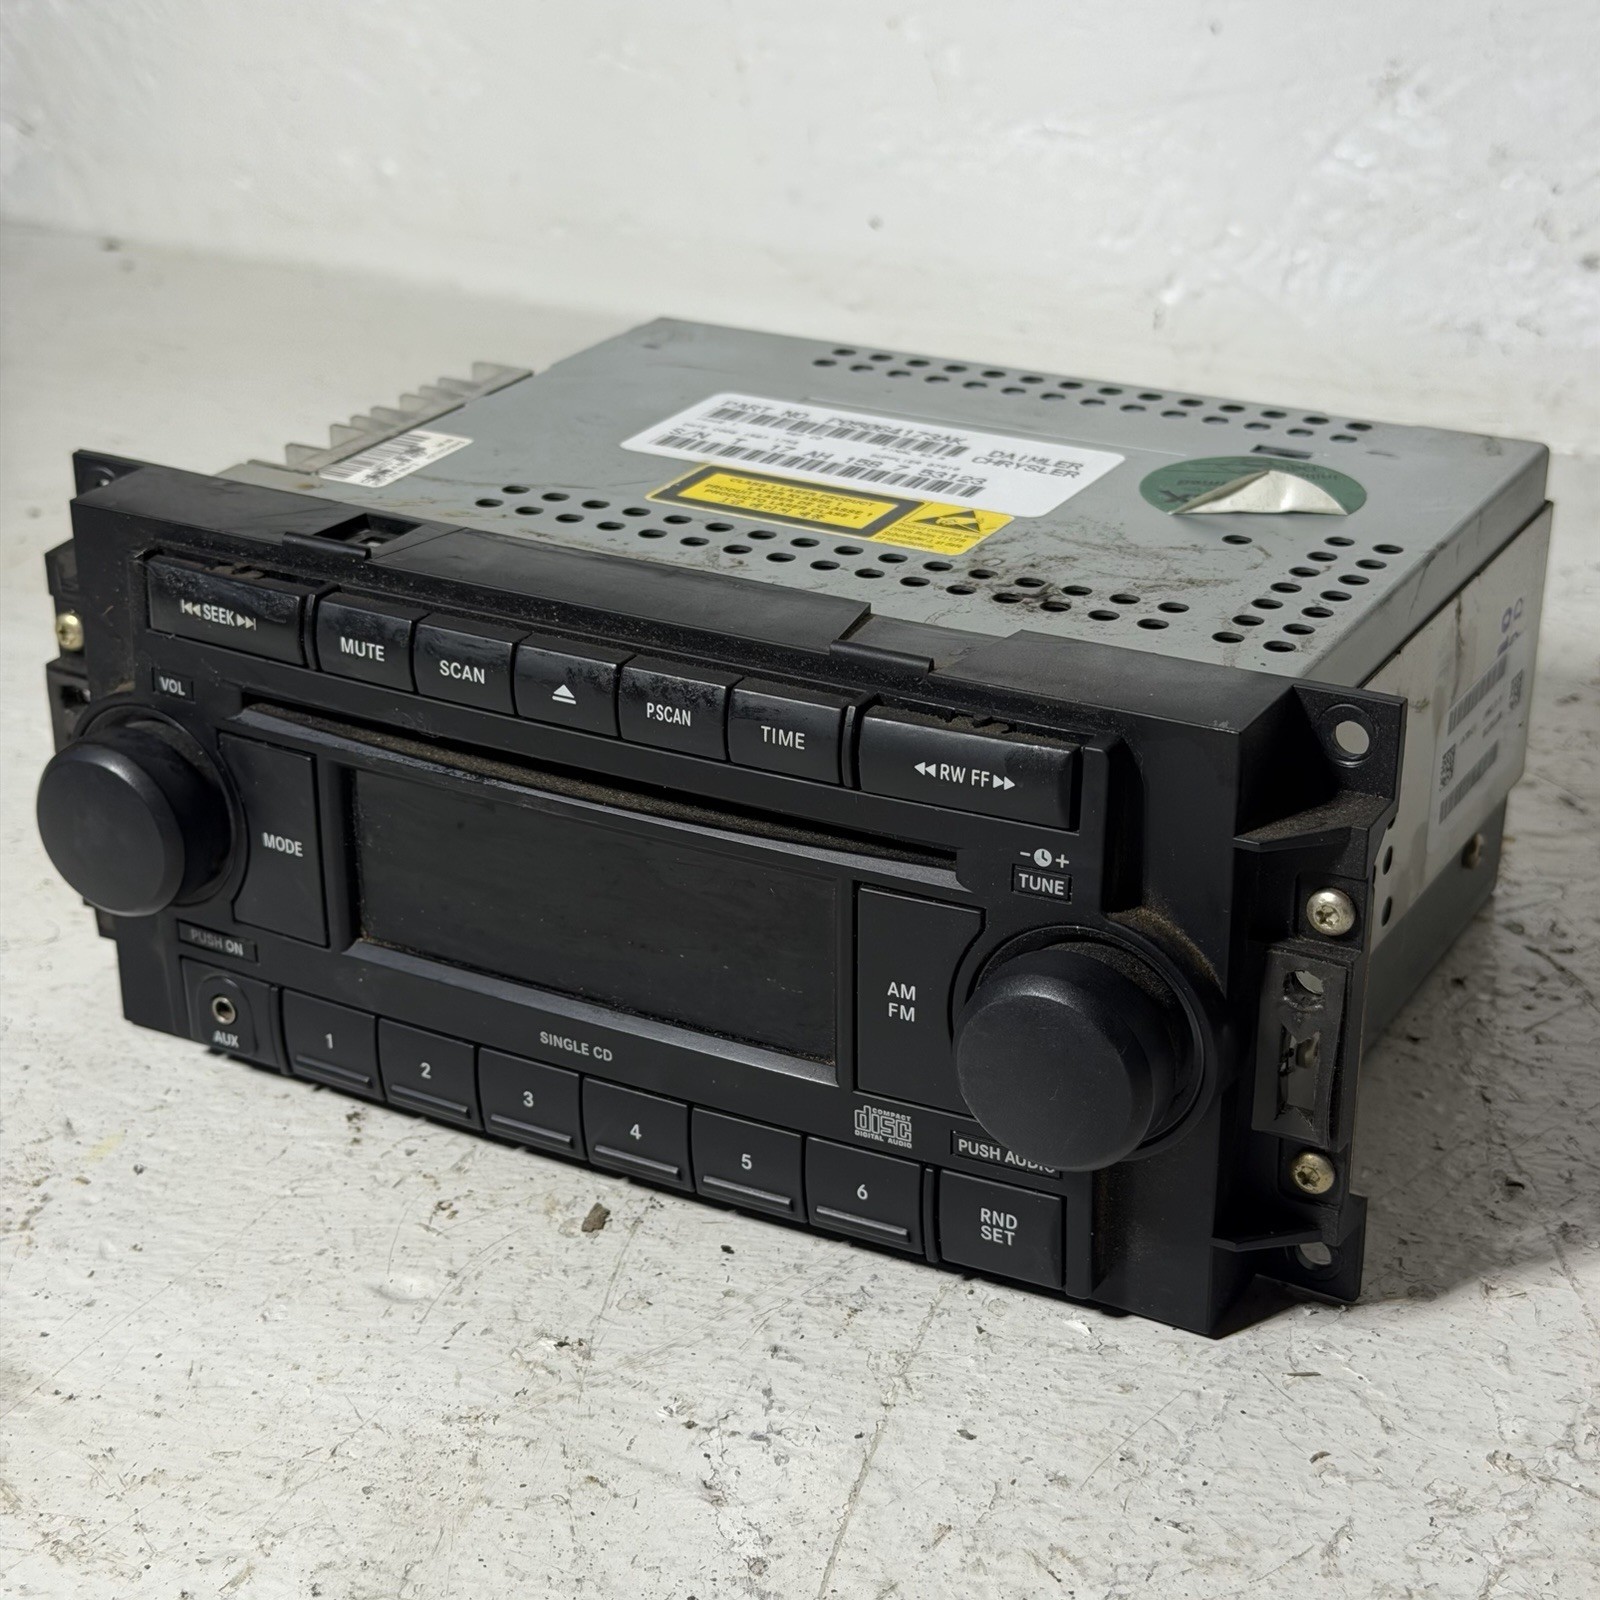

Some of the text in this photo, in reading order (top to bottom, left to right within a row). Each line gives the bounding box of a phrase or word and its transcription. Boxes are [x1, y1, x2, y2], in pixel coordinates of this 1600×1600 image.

[802, 450, 834, 460] AH
[917, 468, 987, 486] 53123
[971, 457, 1080, 479] CHRYSLER
[987, 450, 1083, 471] DAIMLER
[202, 604, 235, 628] SEEK
[339, 636, 385, 663] MUTE
[438, 659, 486, 685] SCAN
[159, 675, 186, 697] VOL
[760, 725, 806, 751] TIME
[939, 764, 990, 789] RW FF
[262, 832, 304, 858] MODE
[1018, 872, 1065, 897] TUNE
[190, 927, 244, 957] PUSH ON
[887, 981, 917, 1002] AM
[888, 1002, 916, 1023] FM
[212, 1030, 240, 1048] AUX
[325, 1033, 333, 1050] 1
[539, 1030, 614, 1062] SINGLE CD
[419, 1062, 432, 1080] 2
[523, 1091, 534, 1108] 3
[872, 1107, 912, 1122] COMPACT
[630, 1124, 642, 1141] 4
[854, 1129, 913, 1149] DIGITAL AUDIO
[958, 1138, 1001, 1161] PUSH
[741, 1153, 752, 1170] 5
[856, 1184, 868, 1201] 6
[980, 1207, 1018, 1229] RND
[981, 1225, 1015, 1246] SET
